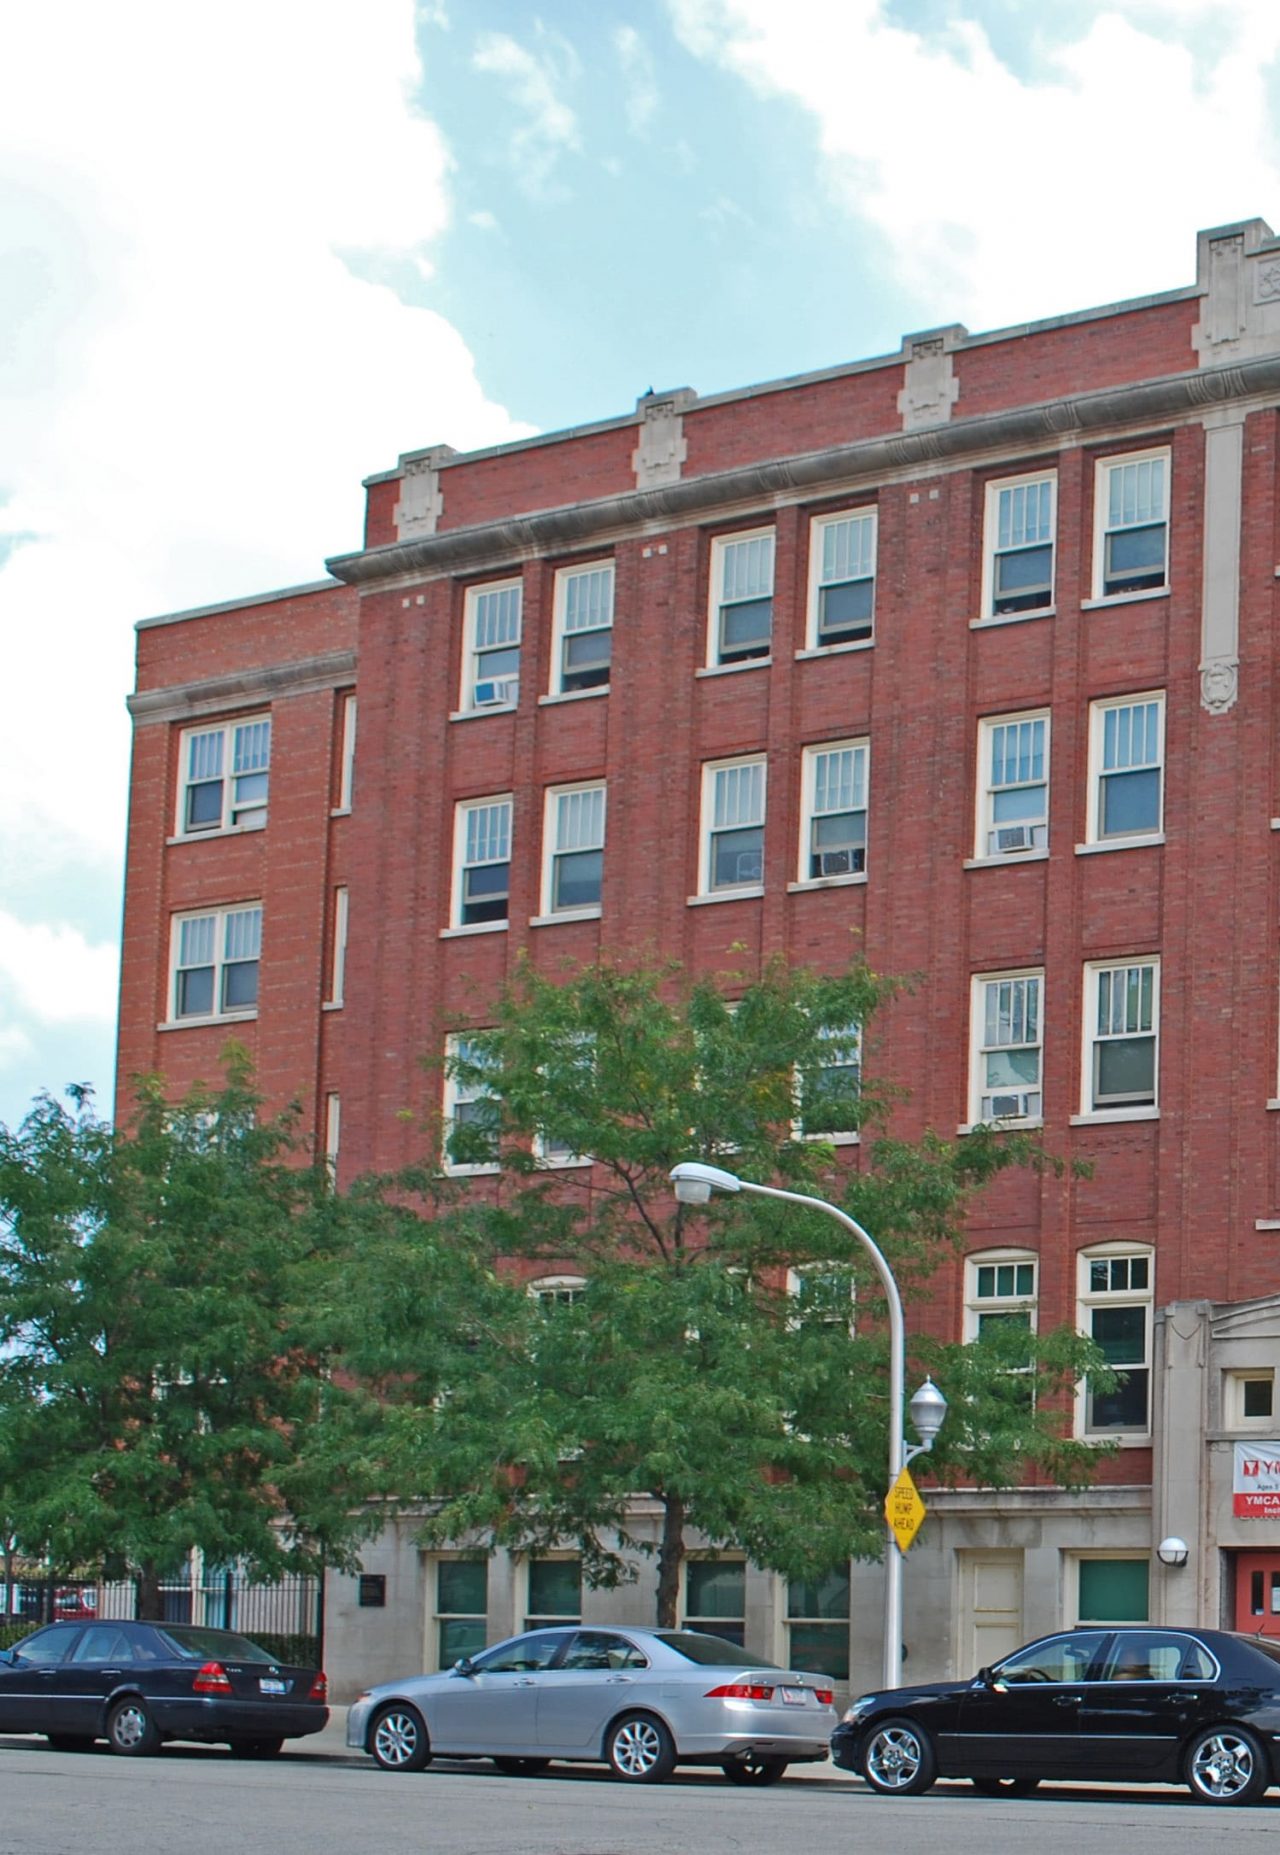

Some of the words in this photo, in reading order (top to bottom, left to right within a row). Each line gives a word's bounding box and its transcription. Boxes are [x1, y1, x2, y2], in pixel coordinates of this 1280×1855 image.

[894, 1486, 913, 1500] SPEED
[1257, 1483, 1273, 1491] Ages
[1246, 1496, 1280, 1505] YMCA
[895, 1503, 913, 1515] HUMP
[894, 1517, 914, 1530] AHEAD
